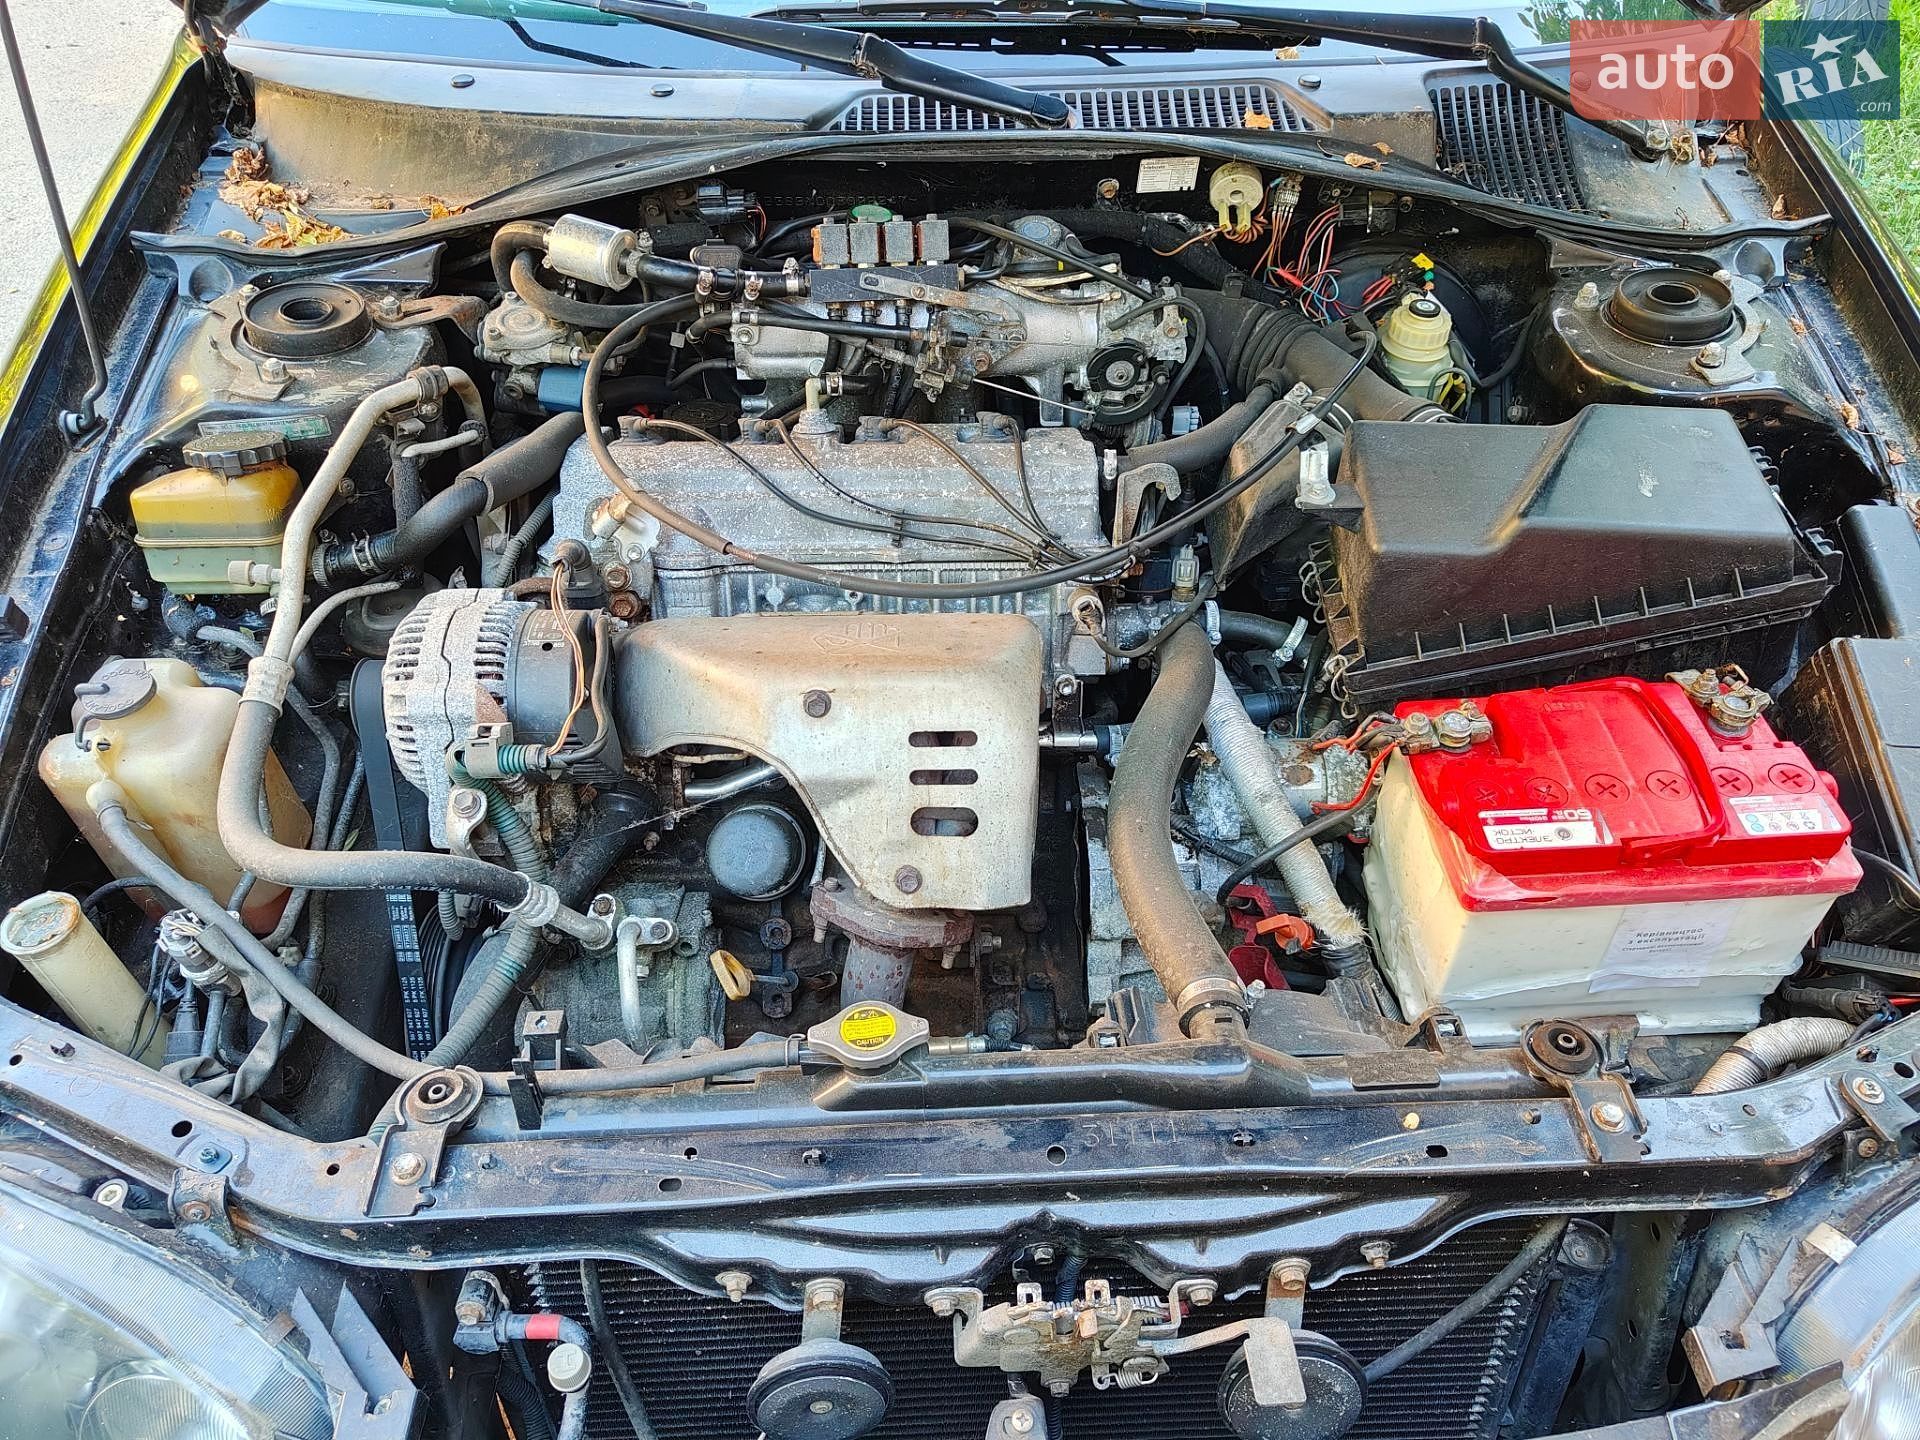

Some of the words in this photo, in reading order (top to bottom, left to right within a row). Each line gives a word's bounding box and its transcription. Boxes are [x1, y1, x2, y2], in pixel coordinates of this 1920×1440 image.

[1493, 828, 1533, 836] ИСТОК
[1496, 835, 1553, 845] ЭЛЕКТРО
[1636, 928, 1704, 938] Керівництво
[1637, 934, 1705, 944] експлуатації
[856, 1036, 884, 1046] CAUTION
